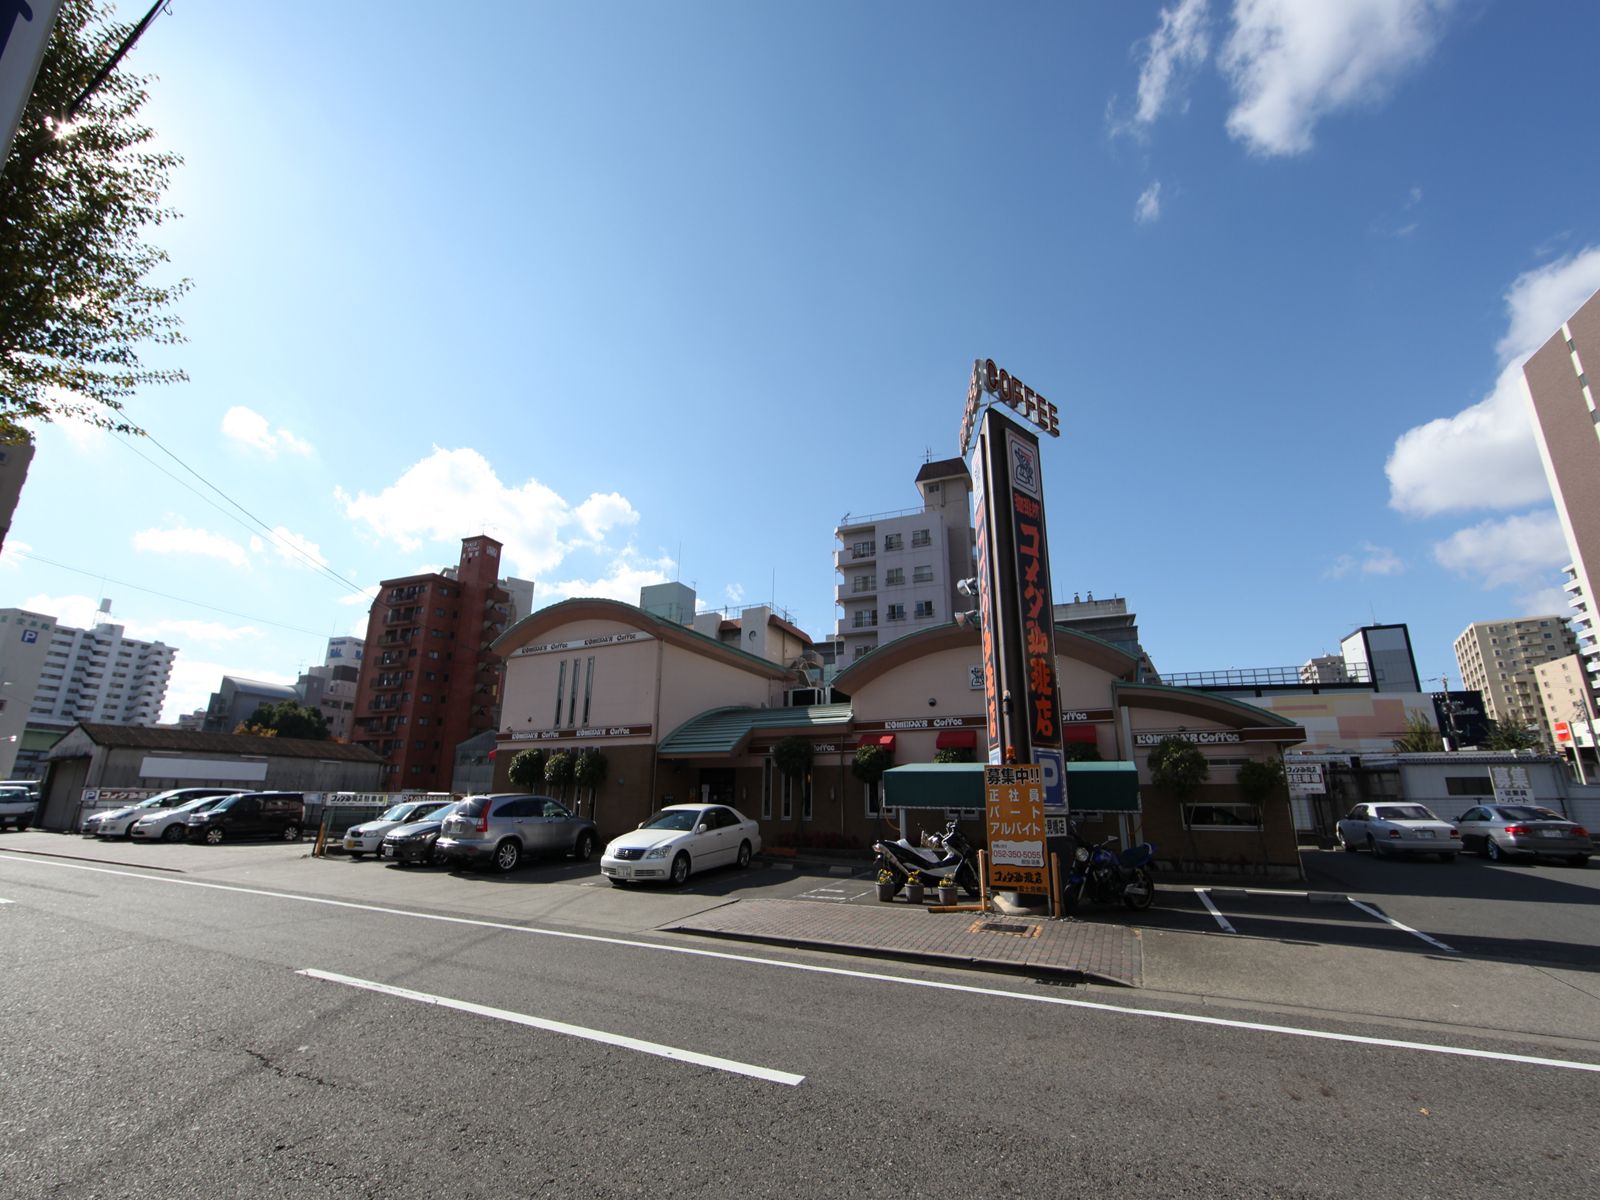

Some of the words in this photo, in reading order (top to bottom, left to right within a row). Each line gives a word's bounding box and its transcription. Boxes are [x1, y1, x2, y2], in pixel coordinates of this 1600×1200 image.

[985, 358, 1060, 437] COFFEE
[24, 631, 36, 642] P
[1019, 523, 1054, 737] コメダ珈琲店
[933, 718, 963, 727] Coffee
[1062, 711, 1088, 721] offee
[1199, 733, 1240, 743] Coffee
[987, 768, 1040, 785] 募集中!!
[1041, 758, 1059, 800] P
[989, 822, 1041, 836] アルバイト
